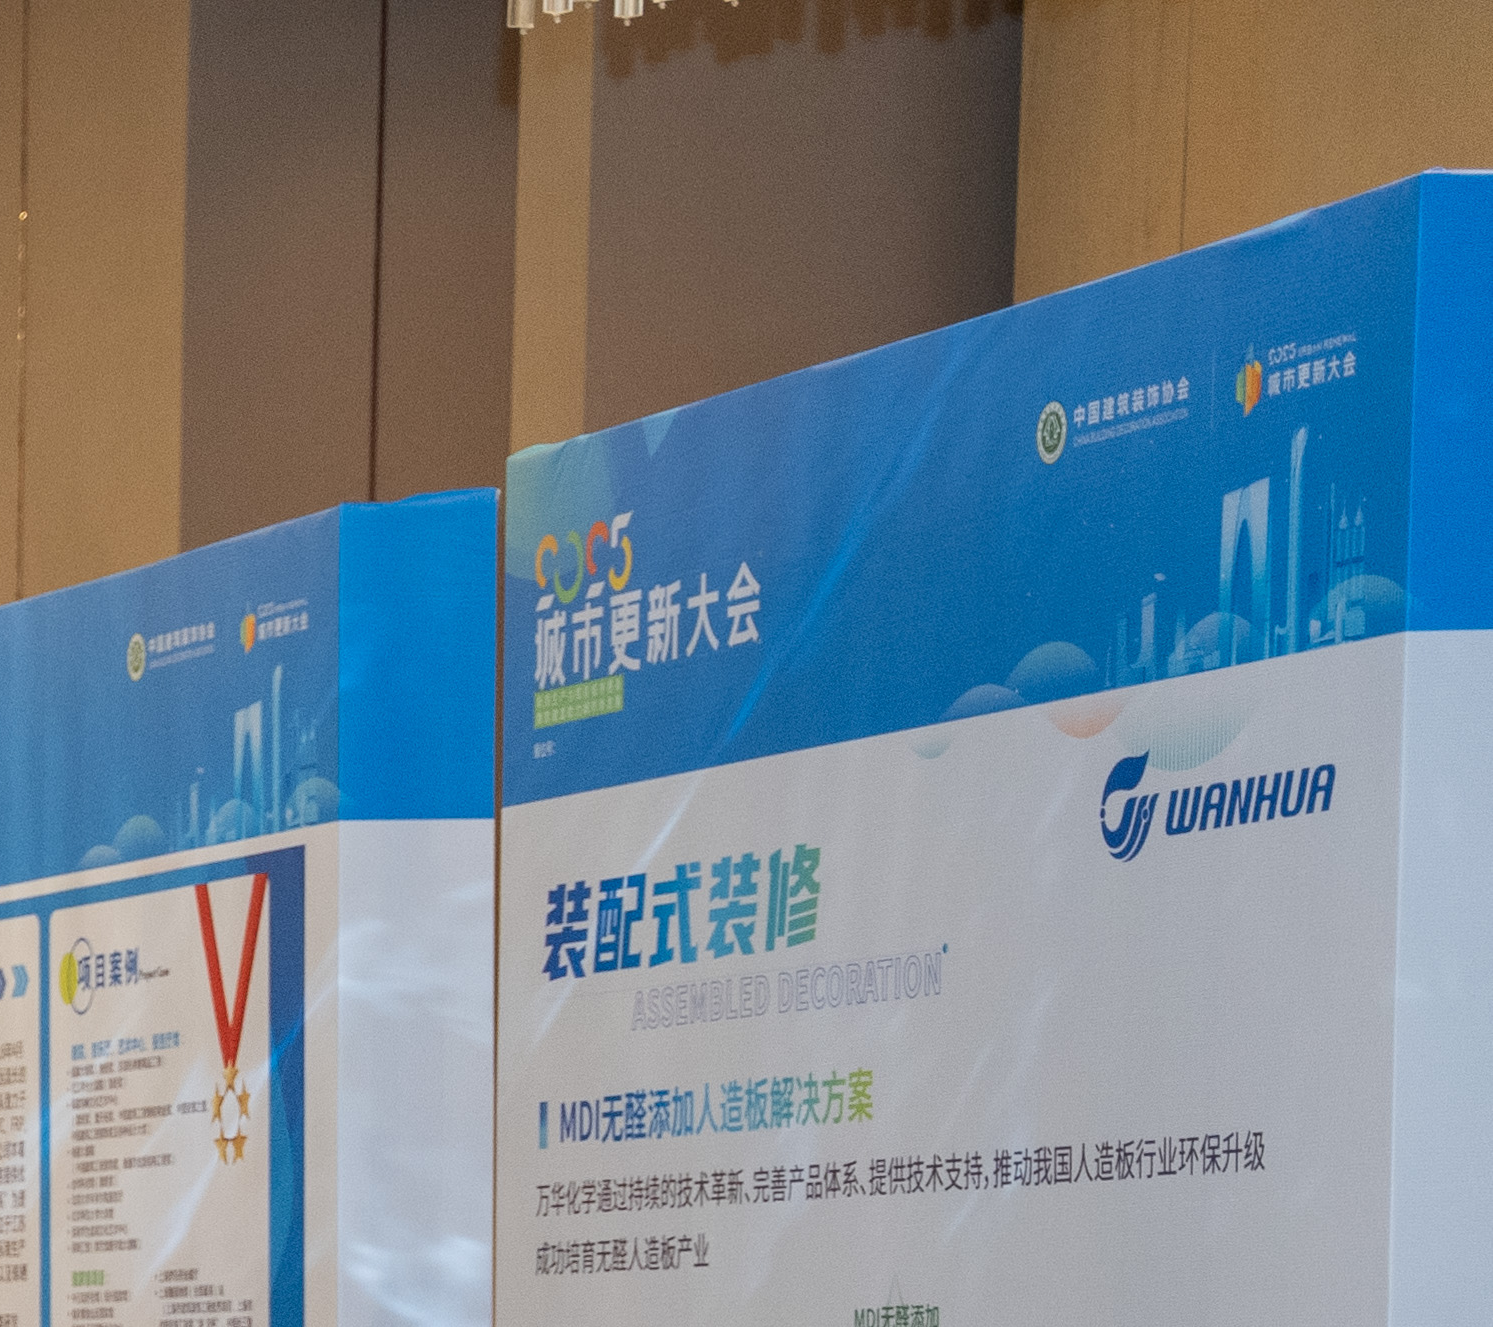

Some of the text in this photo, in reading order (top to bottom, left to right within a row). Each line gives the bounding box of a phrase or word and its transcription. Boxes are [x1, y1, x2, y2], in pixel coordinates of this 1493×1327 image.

[1073, 376, 1190, 428] 中国建筑装饰协会
[1267, 350, 1357, 397] 城市更新大会
[534, 561, 761, 690] 城市更新大会
[1165, 763, 1336, 836] WANHUA
[542, 842, 822, 981] 装配式装修
[77, 948, 139, 991] 项目案例
[632, 951, 944, 1031] ASSEMBLED DECORATION
[559, 1067, 874, 1143] MDI无醛添加人造板解决方案
[534, 1232, 710, 1275] 成功培育无醛人造板产业
